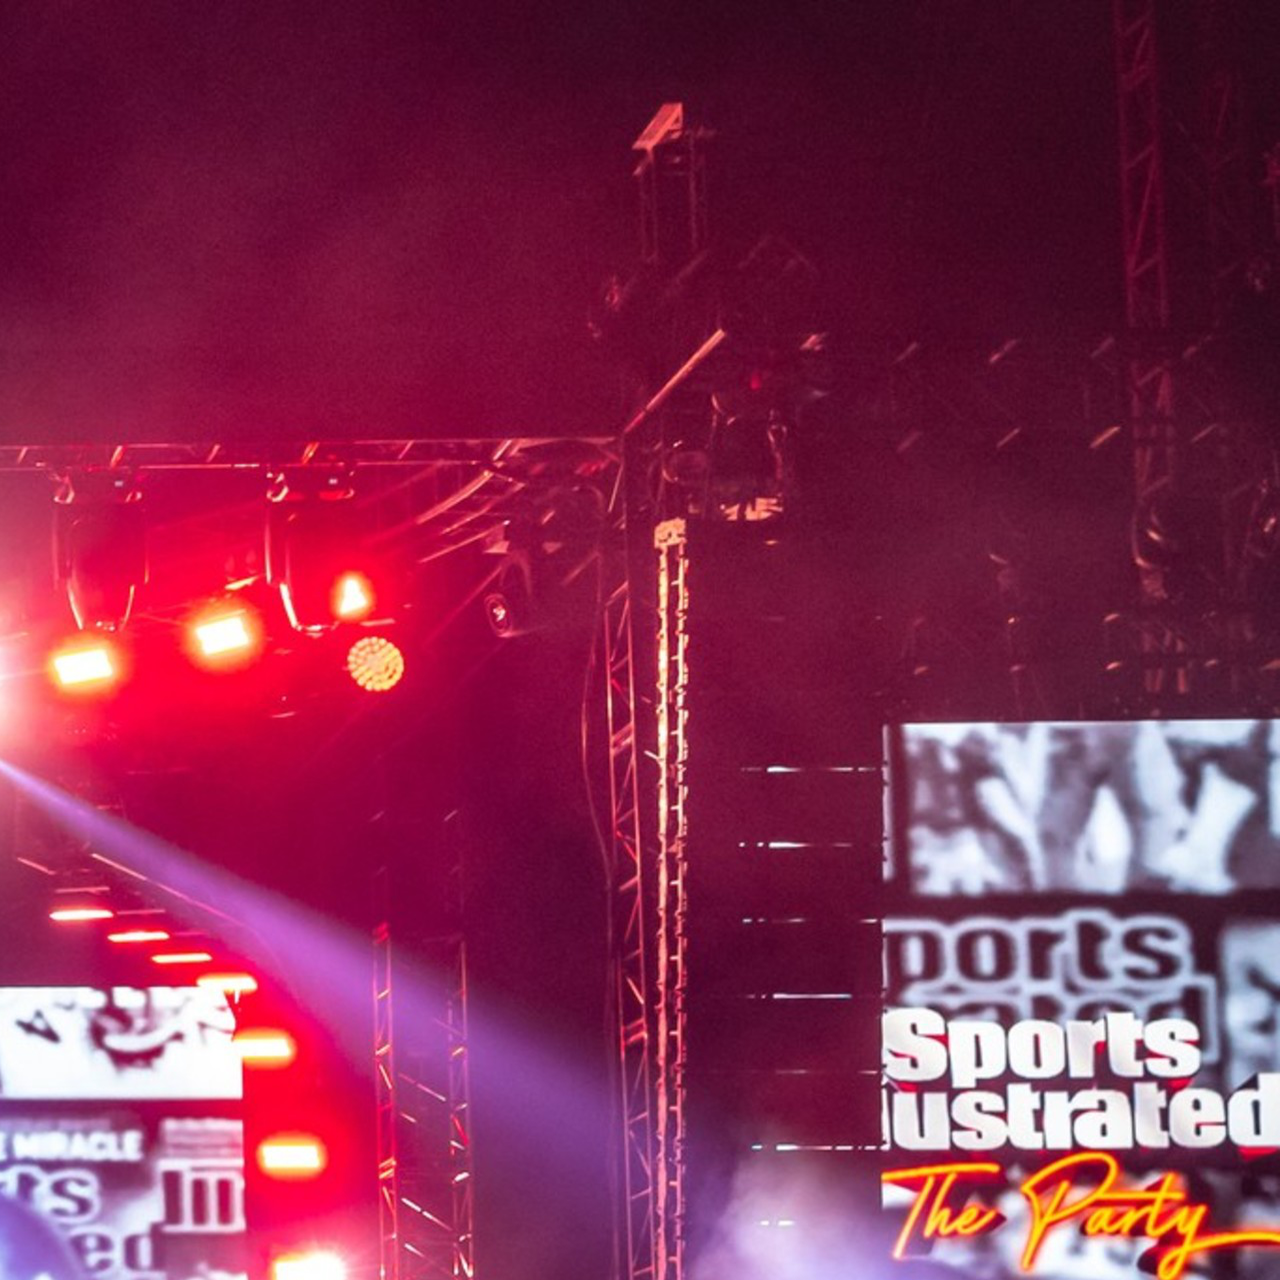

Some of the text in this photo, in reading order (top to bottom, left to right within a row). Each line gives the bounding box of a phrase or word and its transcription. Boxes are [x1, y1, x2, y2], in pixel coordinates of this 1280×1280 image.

[883, 1007, 1201, 1088] Sports
[12, 1130, 143, 1161] MIRACLE
[884, 1073, 1280, 1151] ustrated
[882, 1162, 1003, 1260] The
